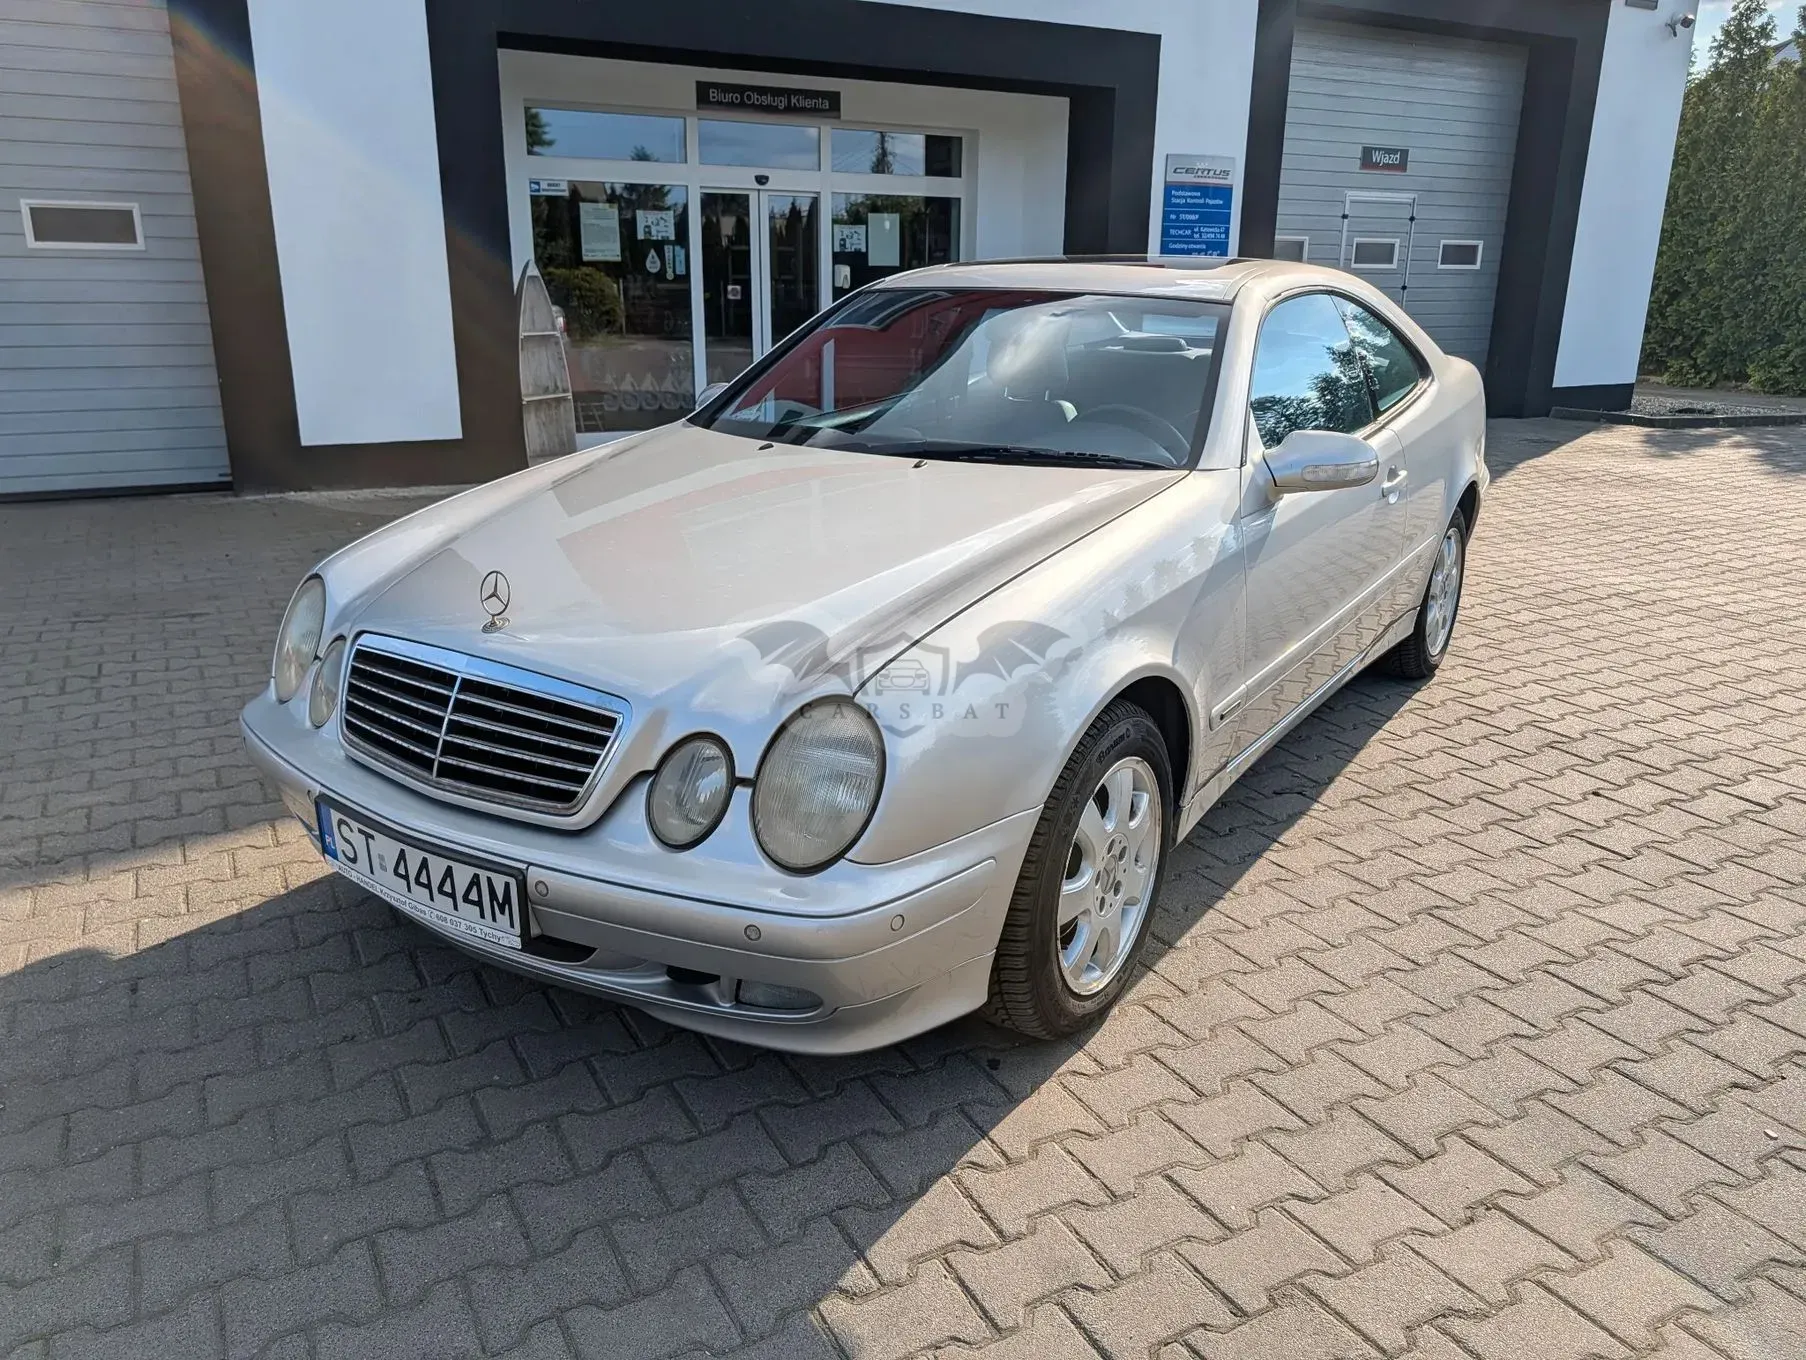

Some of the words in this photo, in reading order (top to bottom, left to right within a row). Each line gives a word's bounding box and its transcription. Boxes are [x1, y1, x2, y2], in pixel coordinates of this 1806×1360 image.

[709, 88, 740, 103] Biuro
[790, 95, 830, 110] Klienta
[1372, 150, 1400, 167] Wjazd
[325, 834, 336, 849] PL
[337, 817, 376, 876] ST
[393, 847, 516, 930] 4444M
